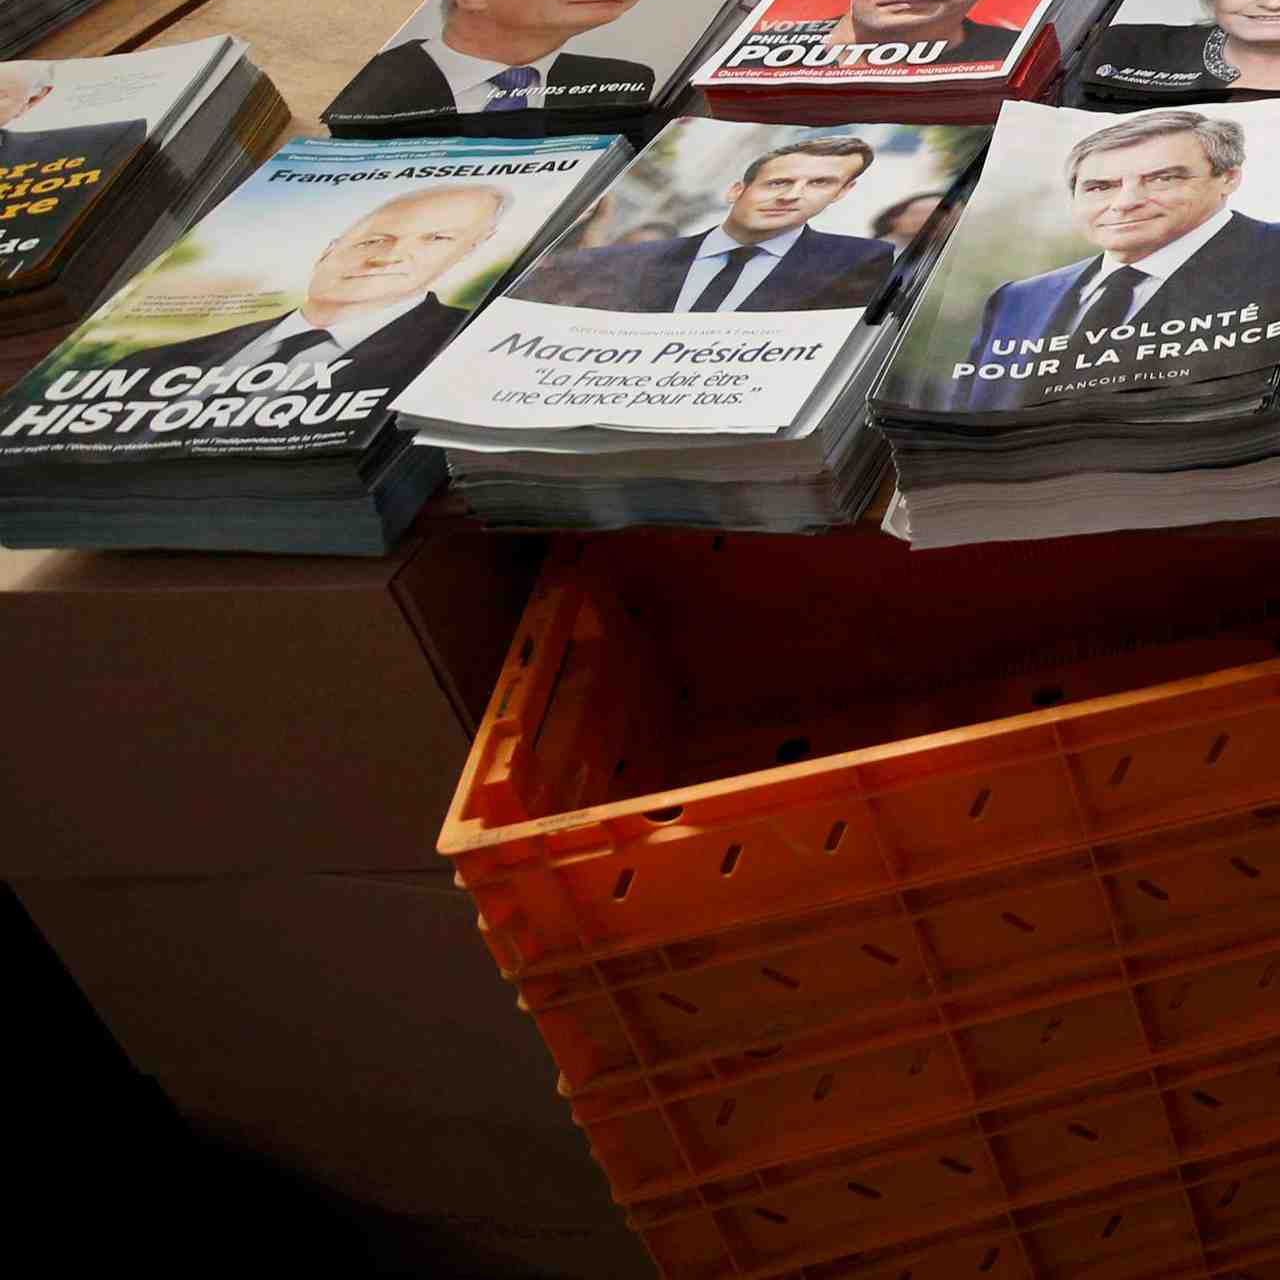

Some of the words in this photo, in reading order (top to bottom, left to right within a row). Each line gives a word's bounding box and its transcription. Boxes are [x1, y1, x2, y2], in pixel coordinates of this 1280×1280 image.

[752, 19, 839, 33] VOTEZ
[747, 32, 833, 45] PHILIPPE
[726, 39, 949, 68] POUTOU
[568, 83, 597, 95] est
[600, 81, 646, 93] venu.
[41, 156, 87, 174] de
[267, 168, 393, 186] François
[395, 158, 580, 181] ASSELINEAU
[991, 333, 1071, 357] UNE
[1085, 302, 1261, 346] VOLONTÉ
[487, 332, 644, 365] Macron
[650, 339, 825, 365] Président
[951, 359, 1061, 381] POUR
[1075, 348, 1121, 370] LA
[1134, 367, 1192, 382] FILLON
[44, 367, 151, 402] UN
[149, 358, 354, 399] CHOIX
[573, 369, 653, 389] France
[655, 370, 702, 388] doit
[703, 370, 751, 388] être
[491, 389, 541, 406] une
[543, 388, 631, 407] chance
[629, 390, 690, 409] pour
[0, 387, 390, 437] HISTORIQUE
